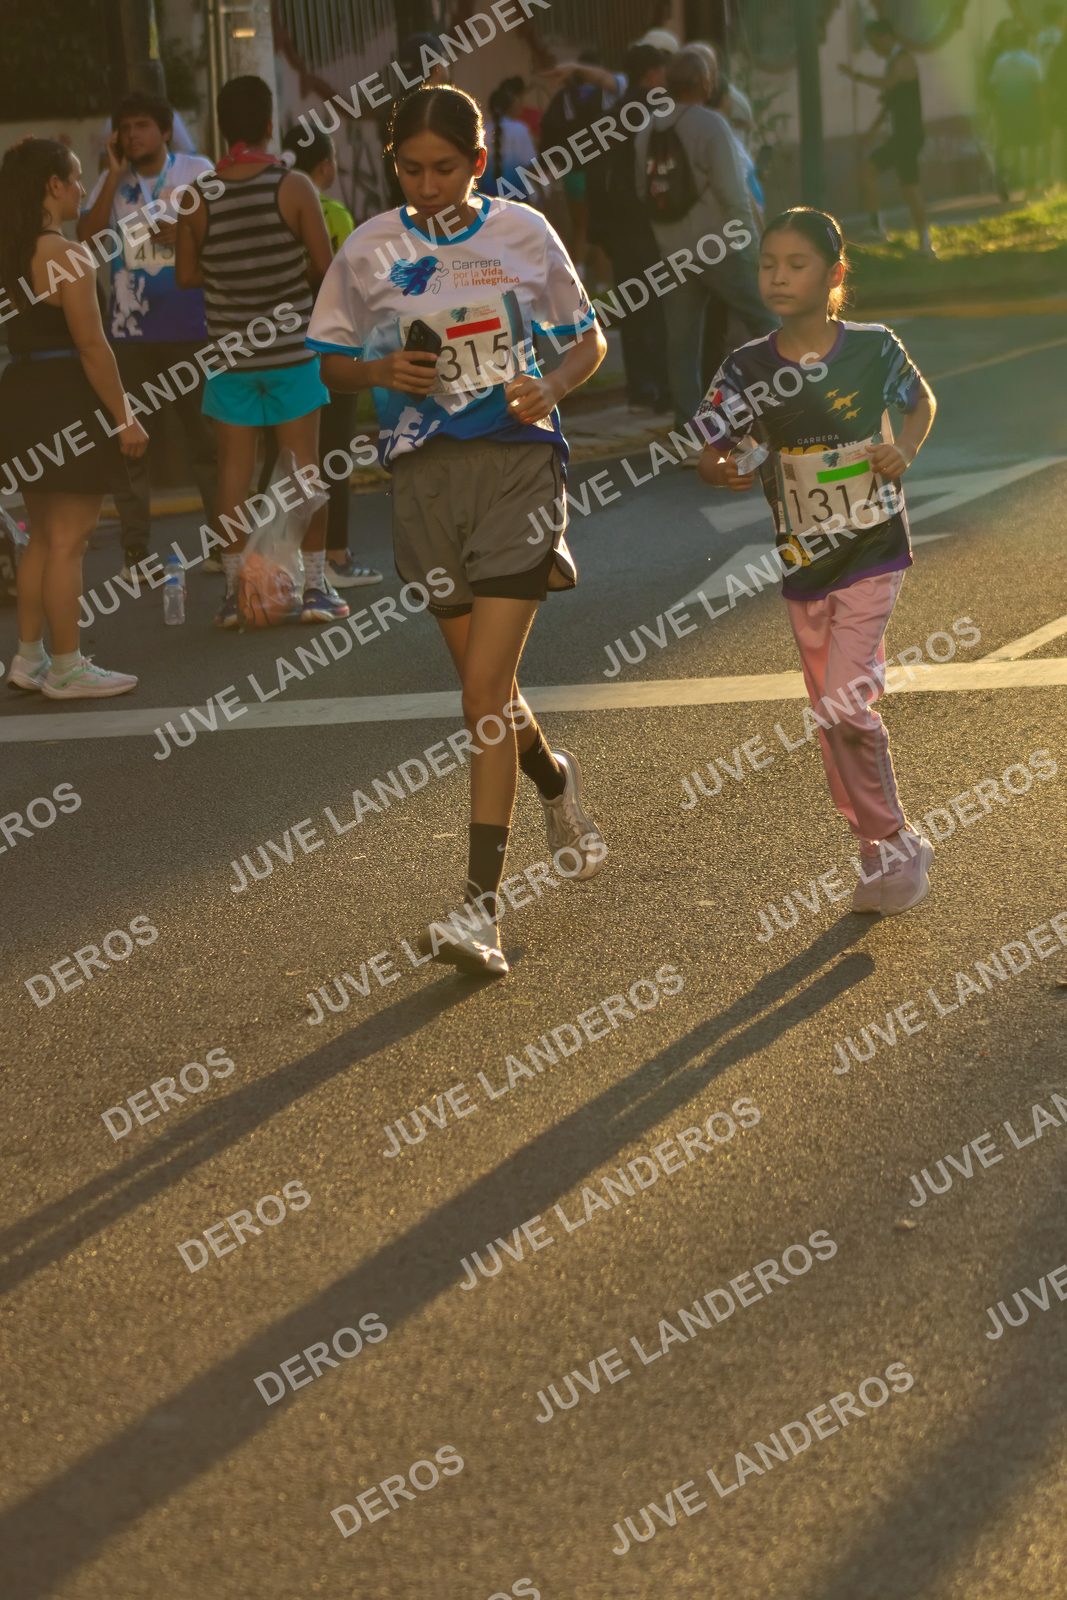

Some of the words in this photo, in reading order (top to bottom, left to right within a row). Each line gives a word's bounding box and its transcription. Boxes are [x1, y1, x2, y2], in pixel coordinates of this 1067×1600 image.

[452, 259, 501, 271] Carrera
[453, 272, 468, 281] por
[471, 270, 479, 278] la
[481, 268, 503, 277] Vida
[453, 281, 459, 289] y
[462, 279, 469, 287] la
[472, 276, 520, 287] Integridad
[439, 331, 511, 383] 315
[797, 434, 840, 445] CARRERA
[789, 472, 883, 524] 1314
